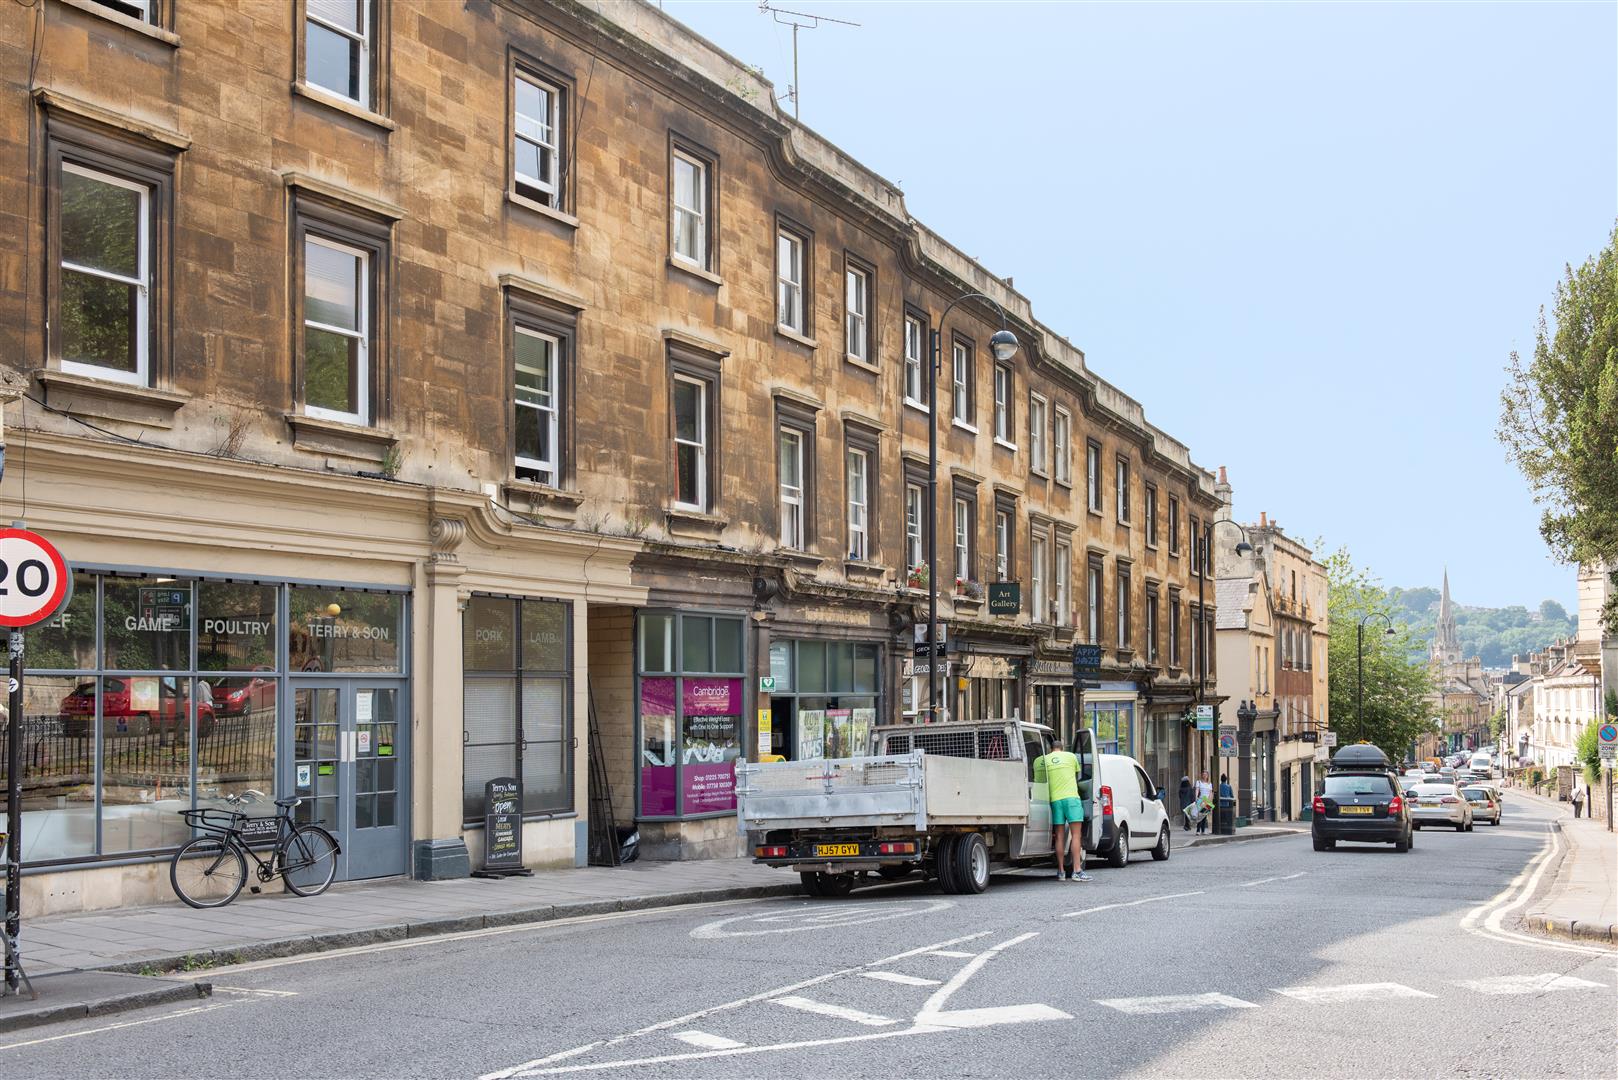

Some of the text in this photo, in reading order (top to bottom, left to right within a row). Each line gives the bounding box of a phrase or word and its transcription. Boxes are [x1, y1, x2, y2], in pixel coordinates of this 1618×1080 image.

[991, 600, 1017, 609] Gallery
[125, 616, 172, 632] GAME
[205, 619, 270, 635] POULTRY
[307, 624, 389, 640] TERRY & SON
[475, 629, 503, 641] PORK
[693, 685, 729, 698] Cambridge
[492, 783, 504, 792] Terry
[508, 783, 517, 791] Son
[818, 844, 857, 855] HJ57 GYV
